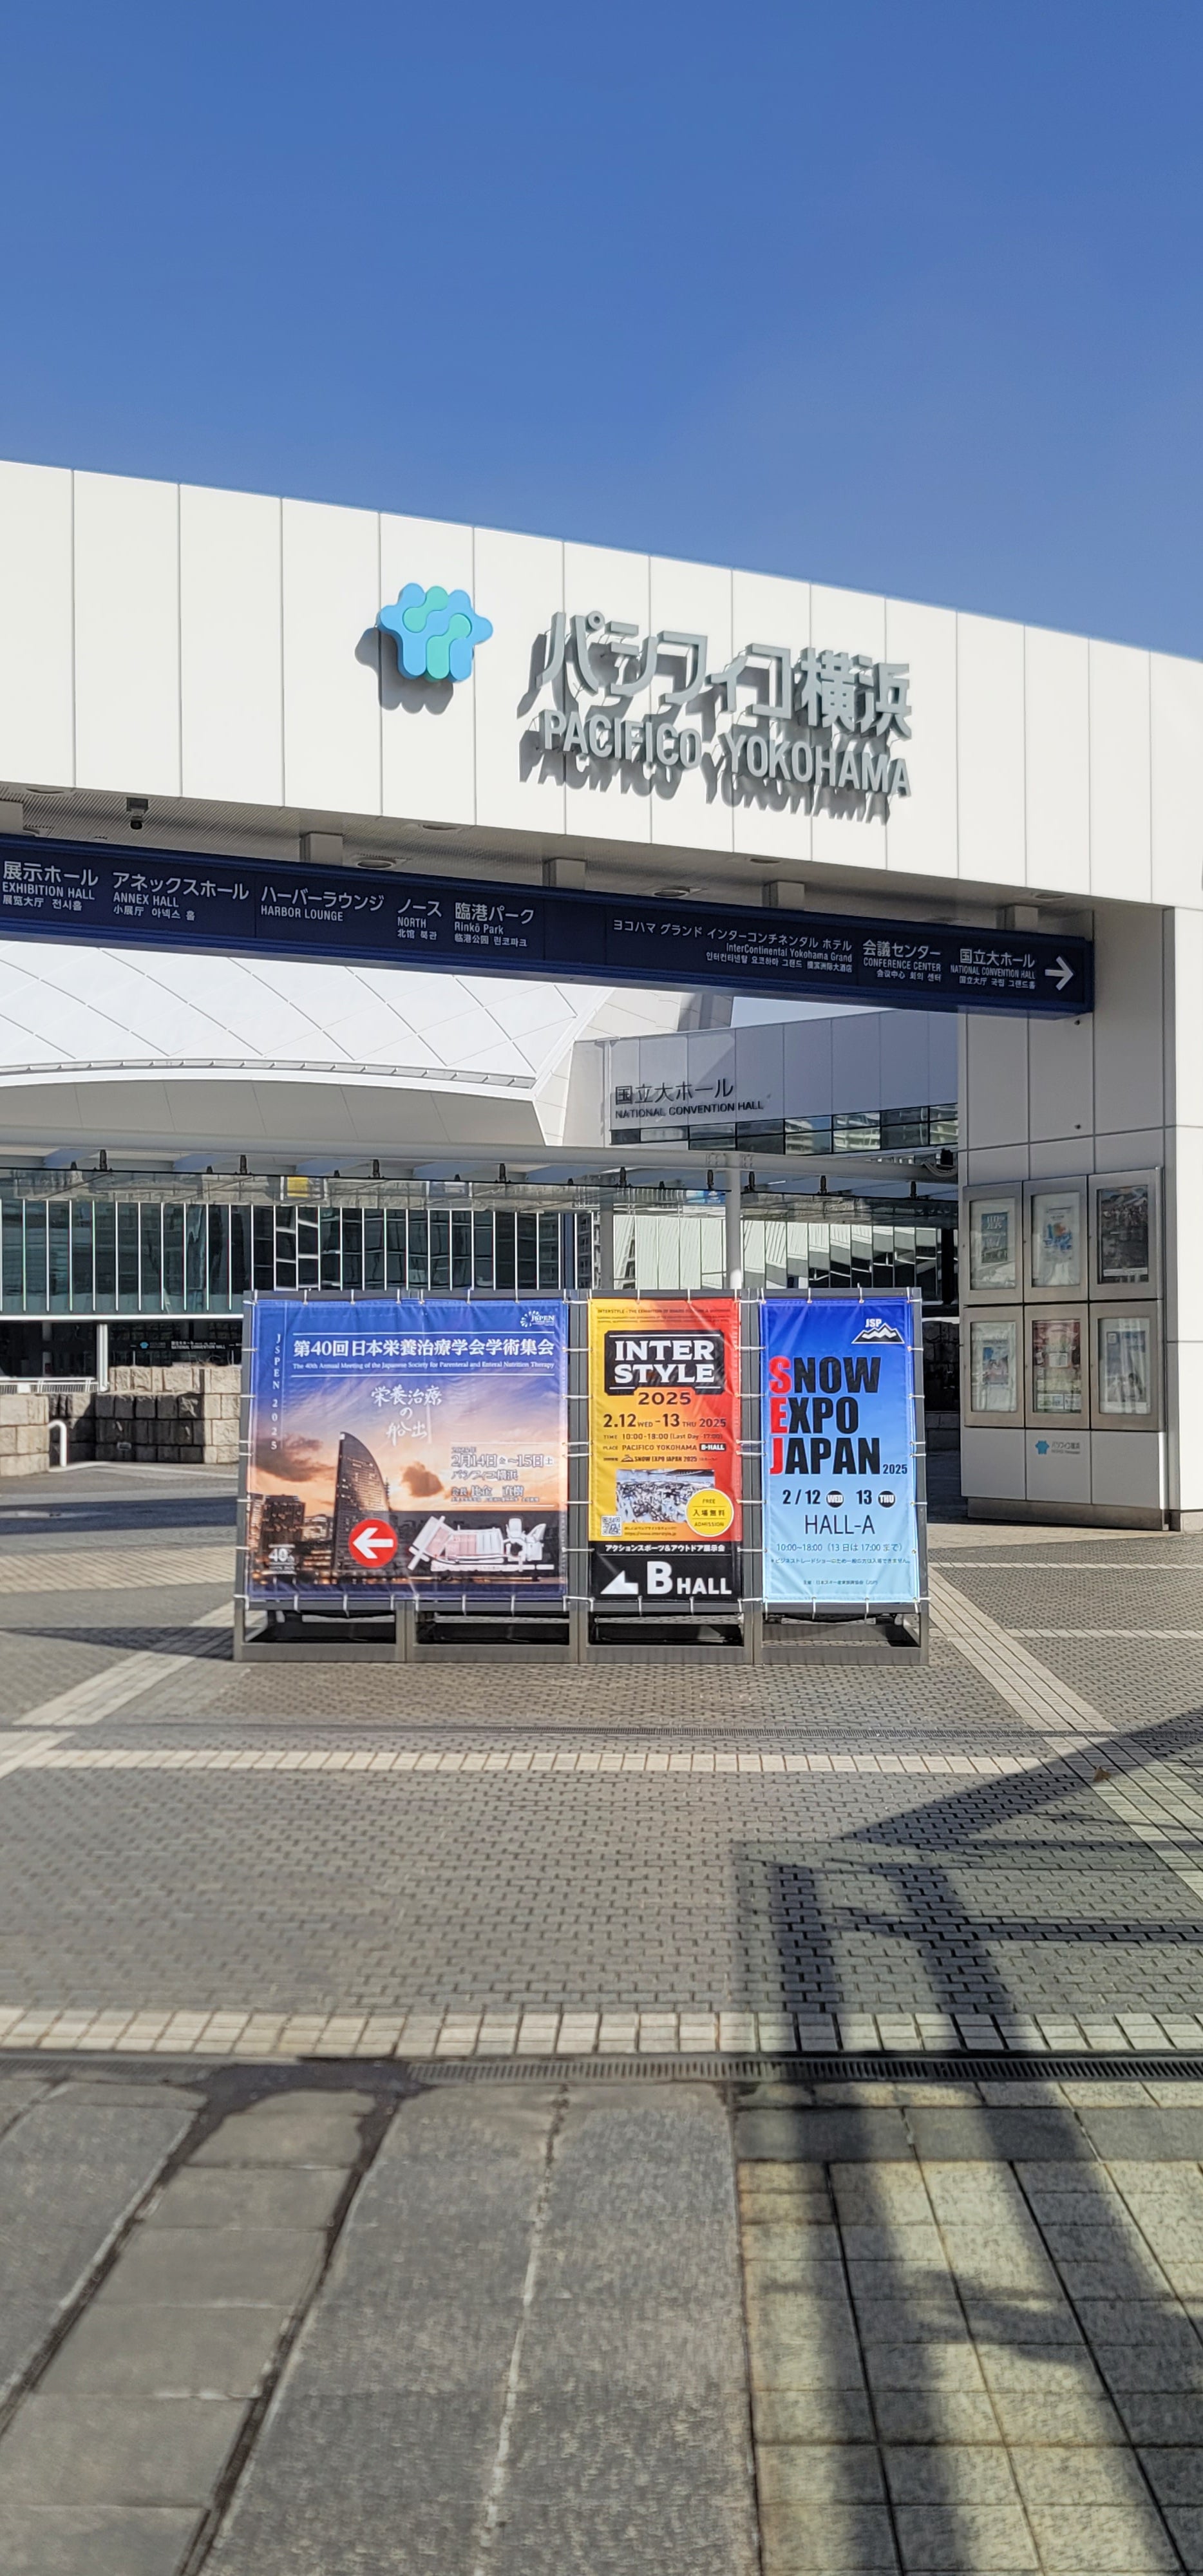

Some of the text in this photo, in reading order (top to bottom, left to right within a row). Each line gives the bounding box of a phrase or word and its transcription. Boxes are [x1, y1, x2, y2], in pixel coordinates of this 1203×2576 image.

[536, 610, 912, 741] パシフィコ横浜
[543, 709, 913, 798] PACIFICO YOKOHAMA
[3, 860, 99, 886] 展示ホール
[2, 882, 95, 900] EXHIBITION HALL
[113, 872, 249, 900] アネックスホール
[3, 895, 44, 908] 展览大厅
[113, 892, 180, 908] ANNEX HALL
[261, 886, 384, 912] ハーバーラウンジ
[397, 899, 442, 918] ノース
[113, 904, 145, 917] 小展厅
[151, 907, 181, 920] 아넥스
[261, 905, 344, 922] HARBOR LOUNGE
[455, 902, 534, 925] 臨港パーク
[397, 916, 426, 929] NORTH
[483, 923, 504, 935] Park
[613, 920, 852, 952] ヨコハマ グランド インターコンチネンタル ホテル
[726, 943, 852, 963] InterContinental Yokohama Grand
[862, 939, 941, 960] 会議センター
[960, 948, 1036, 968] 国立大ホール
[863, 957, 941, 972] CONFERENCE CENTER
[950, 965, 1036, 980] NATIONAL CONVENTION HALL
[615, 1077, 734, 1106] 国立大ホール
[615, 1101, 764, 1119] NATIONAL CONVENTION HALL
[865, 1318, 882, 1328] JSP
[614, 1340, 715, 1361] INTER
[531, 1361, 554, 1369] Therapy
[614, 1364, 715, 1384] STYLE
[769, 1356, 881, 1394] SNOW
[638, 1392, 692, 1405] 2025
[399, 1406, 413, 1421] の
[603, 1414, 636, 1428] 2.12
[699, 1419, 726, 1428] 2025
[770, 1396, 859, 1434] EXPO
[770, 1437, 908, 1475] JAPAN 2025
[827, 1494, 844, 1503] WED
[856, 1489, 872, 1505] 13
[878, 1494, 895, 1503] THU
[693, 1509, 725, 1517] 入場無料
[804, 1514, 875, 1535] HALL-A
[647, 1560, 732, 1595] B HALL
